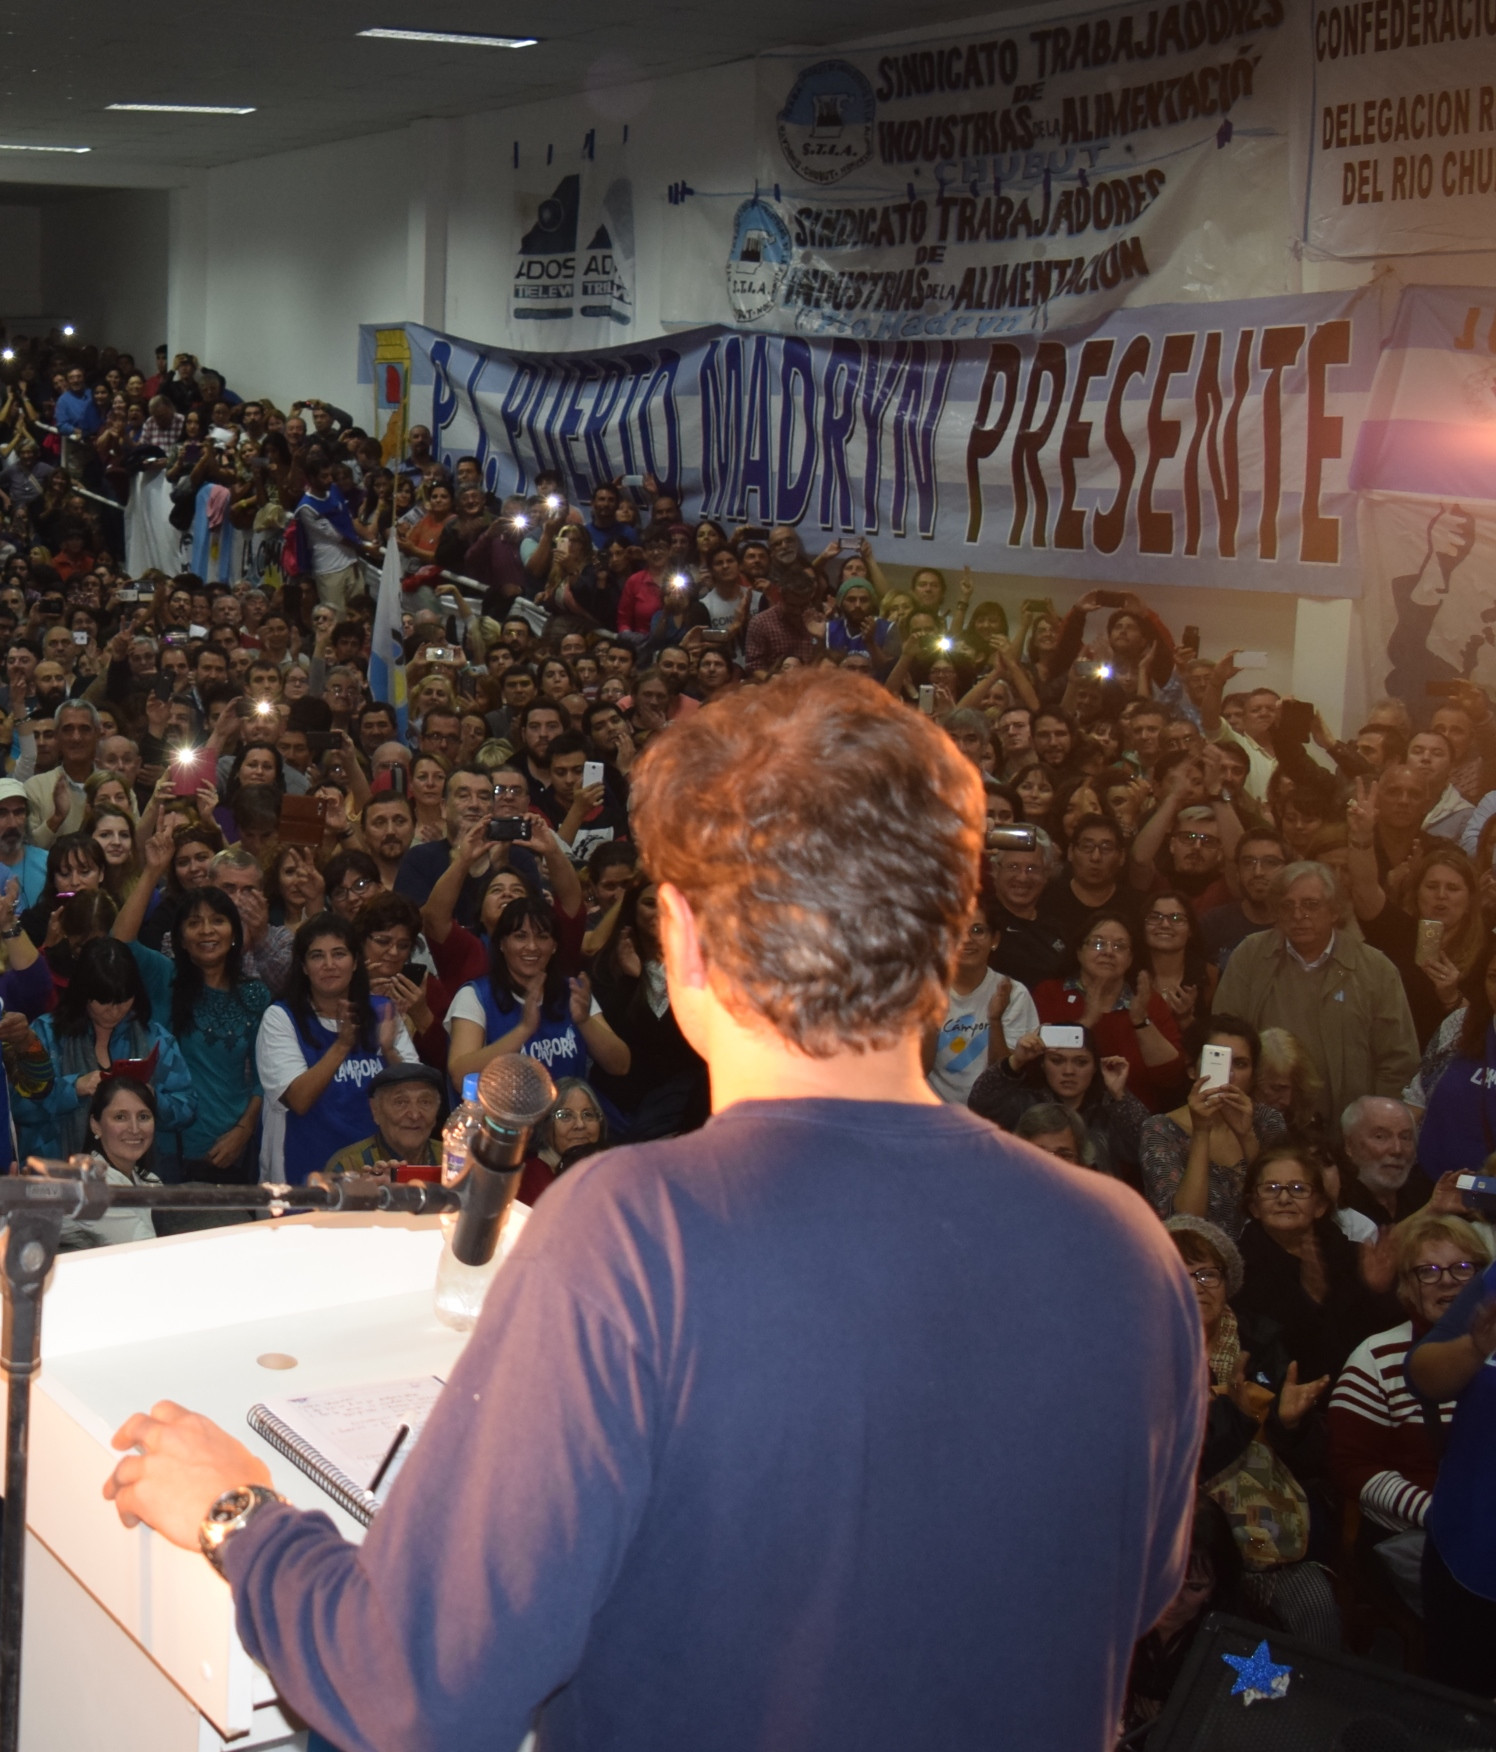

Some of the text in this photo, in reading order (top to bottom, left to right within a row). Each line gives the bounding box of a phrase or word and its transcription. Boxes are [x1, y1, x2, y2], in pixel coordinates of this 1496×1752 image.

[877, 38, 1017, 102] SINDICATO
[1030, 0, 1284, 79] TRABAJADORES
[1316, 0, 1496, 62] CONFEDERACIO
[1012, 81, 1045, 104] DE
[1322, 88, 1471, 150] DELEGACION
[878, 104, 1033, 164] INDUSTRIAS
[934, 147, 1111, 186] CHUBUT
[1342, 159, 1384, 205] DEL
[1391, 153, 1433, 201] RIO
[795, 199, 928, 248] SINDICATO
[939, 168, 1166, 243] TRABAJADORES
[915, 245, 946, 265] DE
[954, 236, 1149, 311] ALIMENTACION
[503, 348, 683, 511] PUERTO
[698, 334, 955, 537] MADRYN
[964, 320, 1351, 565] PRESENTE
